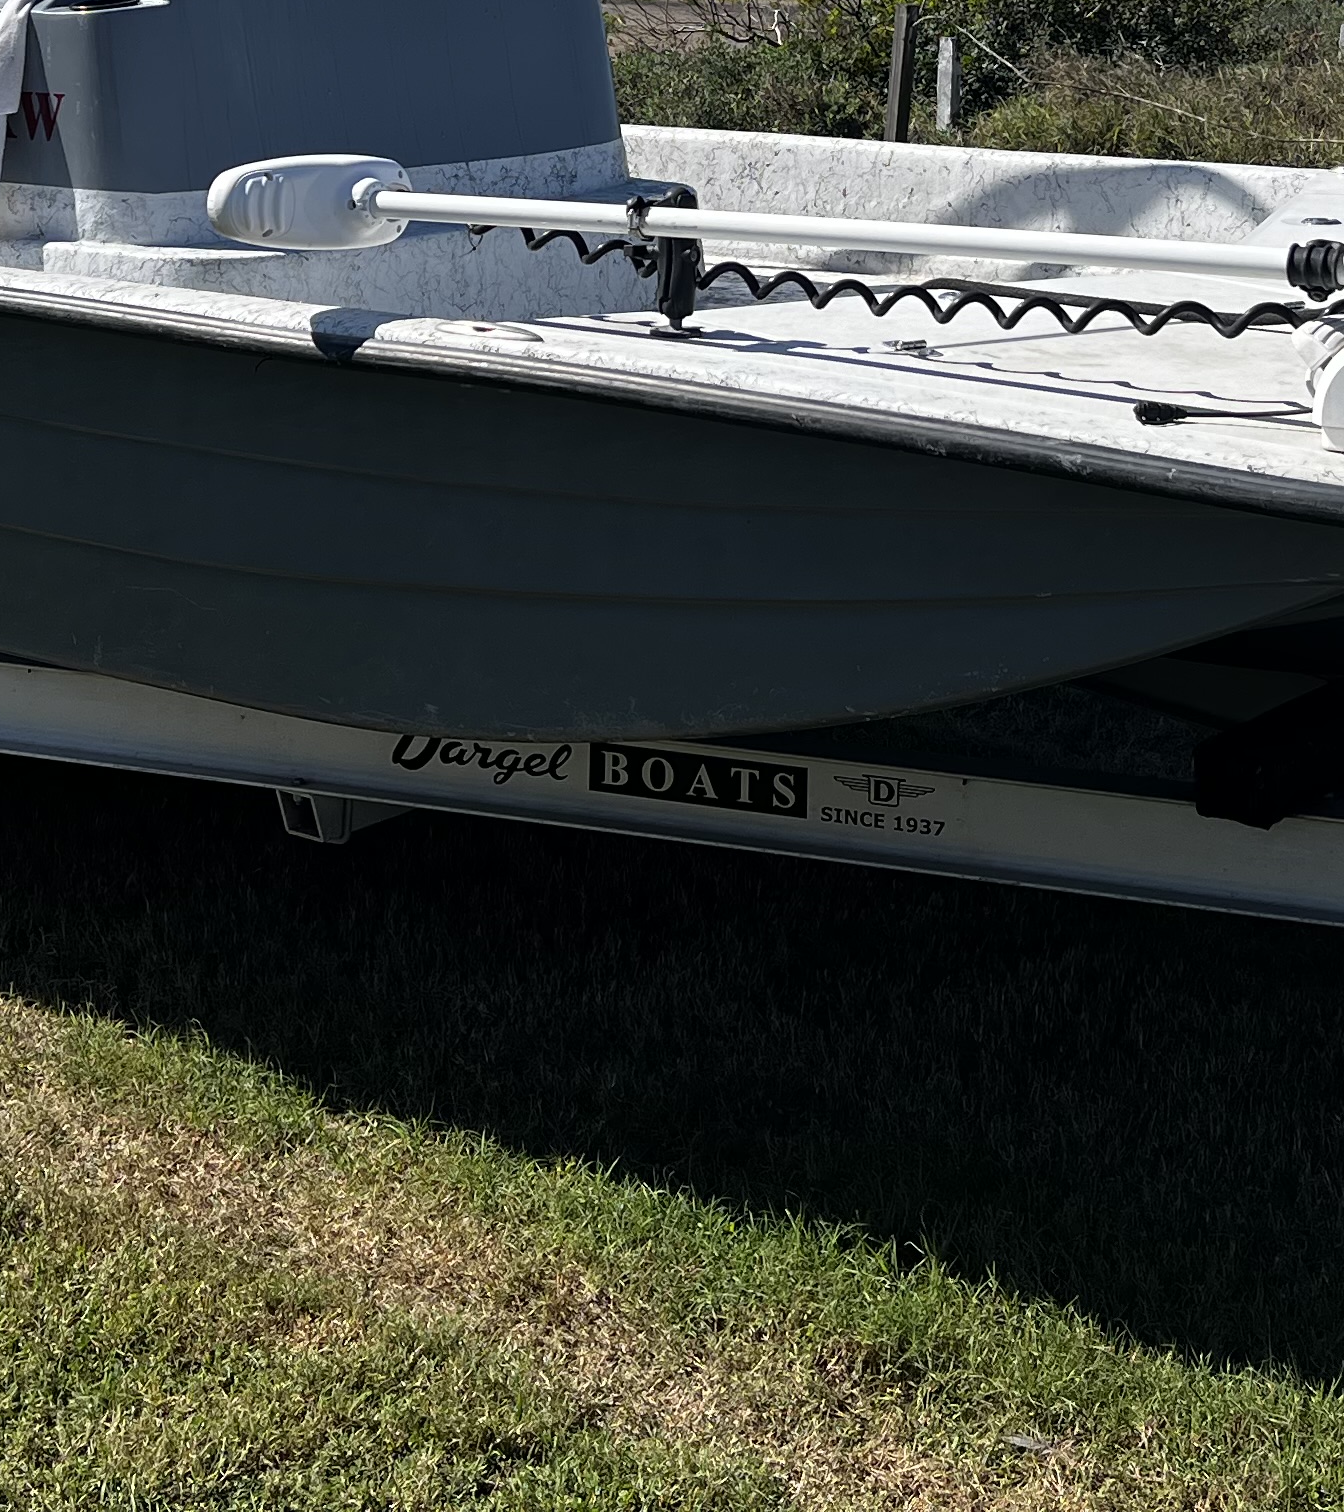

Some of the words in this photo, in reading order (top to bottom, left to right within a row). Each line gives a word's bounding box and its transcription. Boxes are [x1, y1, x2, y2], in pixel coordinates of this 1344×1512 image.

[392, 734, 573, 785] Dargel
[601, 750, 798, 808] BOATS
[820, 807, 885, 829] SINCE
[893, 816, 945, 836] 1937
